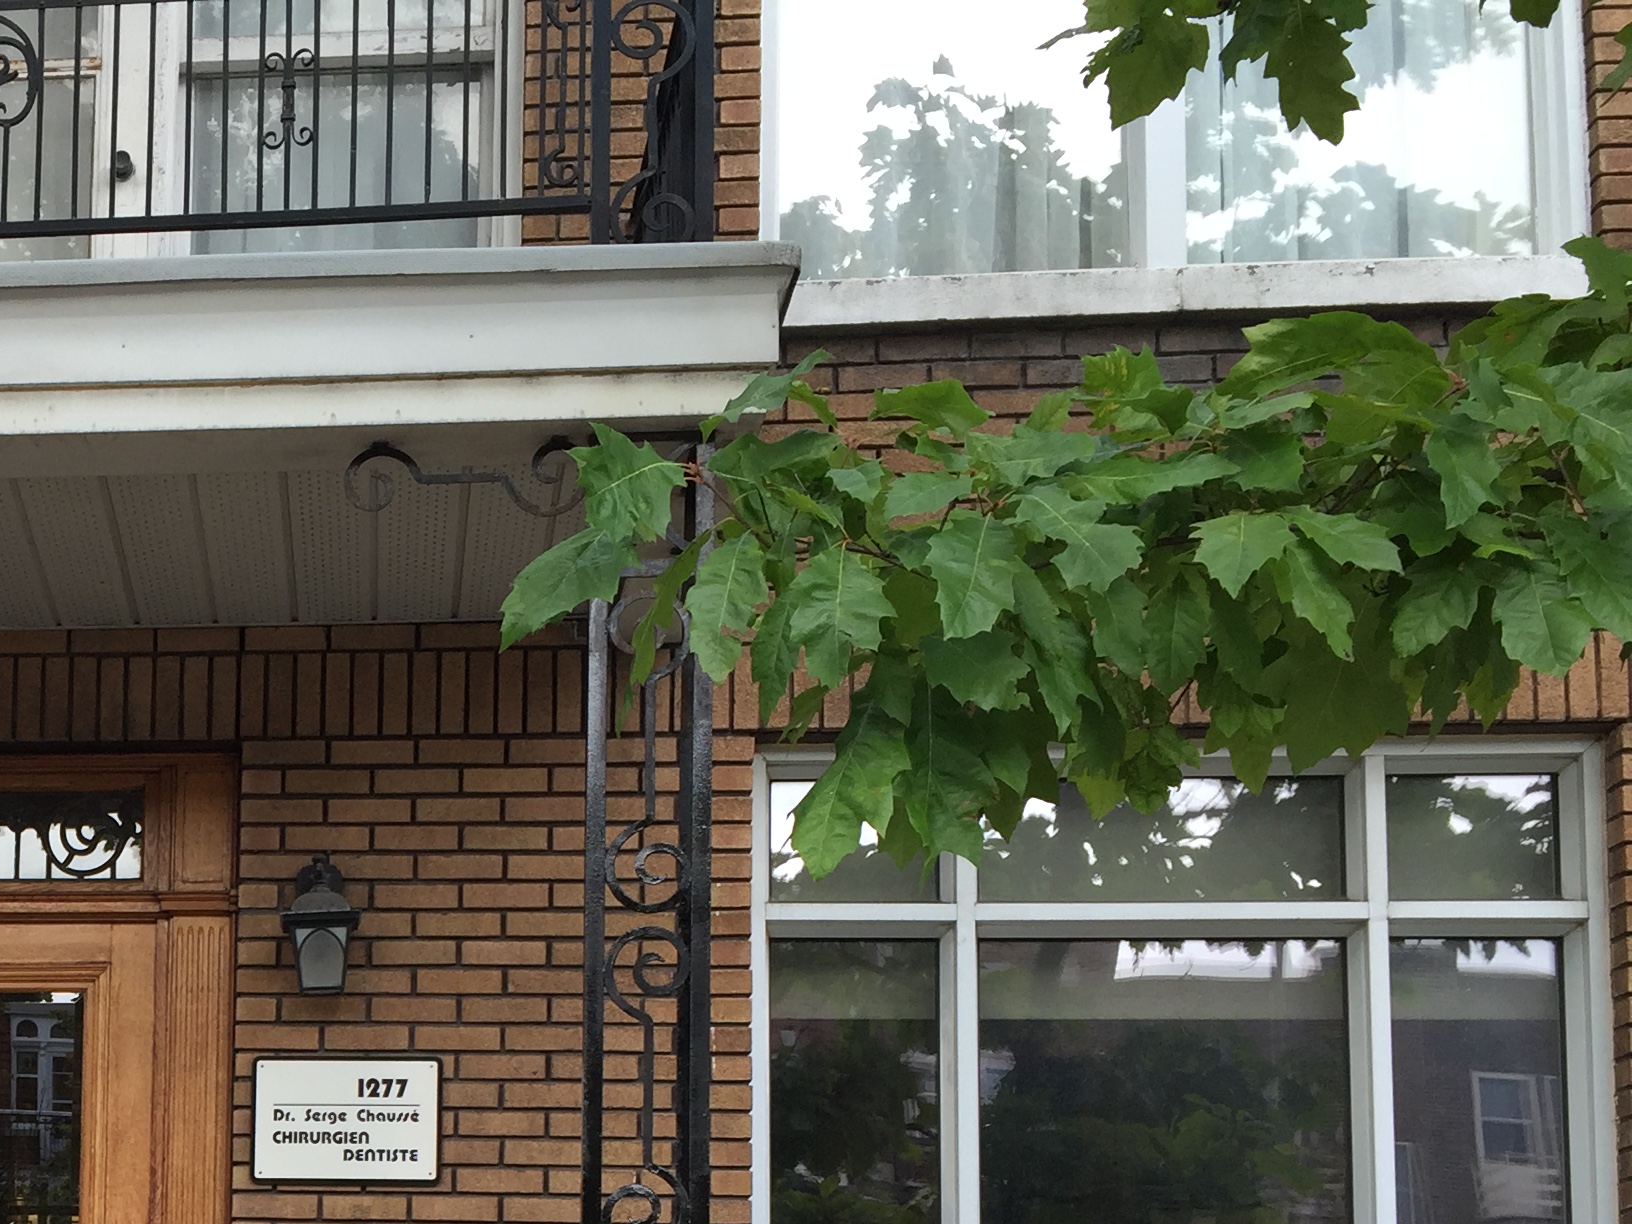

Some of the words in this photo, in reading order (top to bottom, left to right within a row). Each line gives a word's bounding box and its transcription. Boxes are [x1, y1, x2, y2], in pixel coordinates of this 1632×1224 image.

[357, 1078, 408, 1098] 1277
[273, 1108, 296, 1122] Dr.
[304, 1108, 348, 1125] Serge
[356, 1108, 420, 1123] Chaussé
[272, 1131, 369, 1144] CHIRURGIEN
[342, 1149, 418, 1162] DENTISTE
